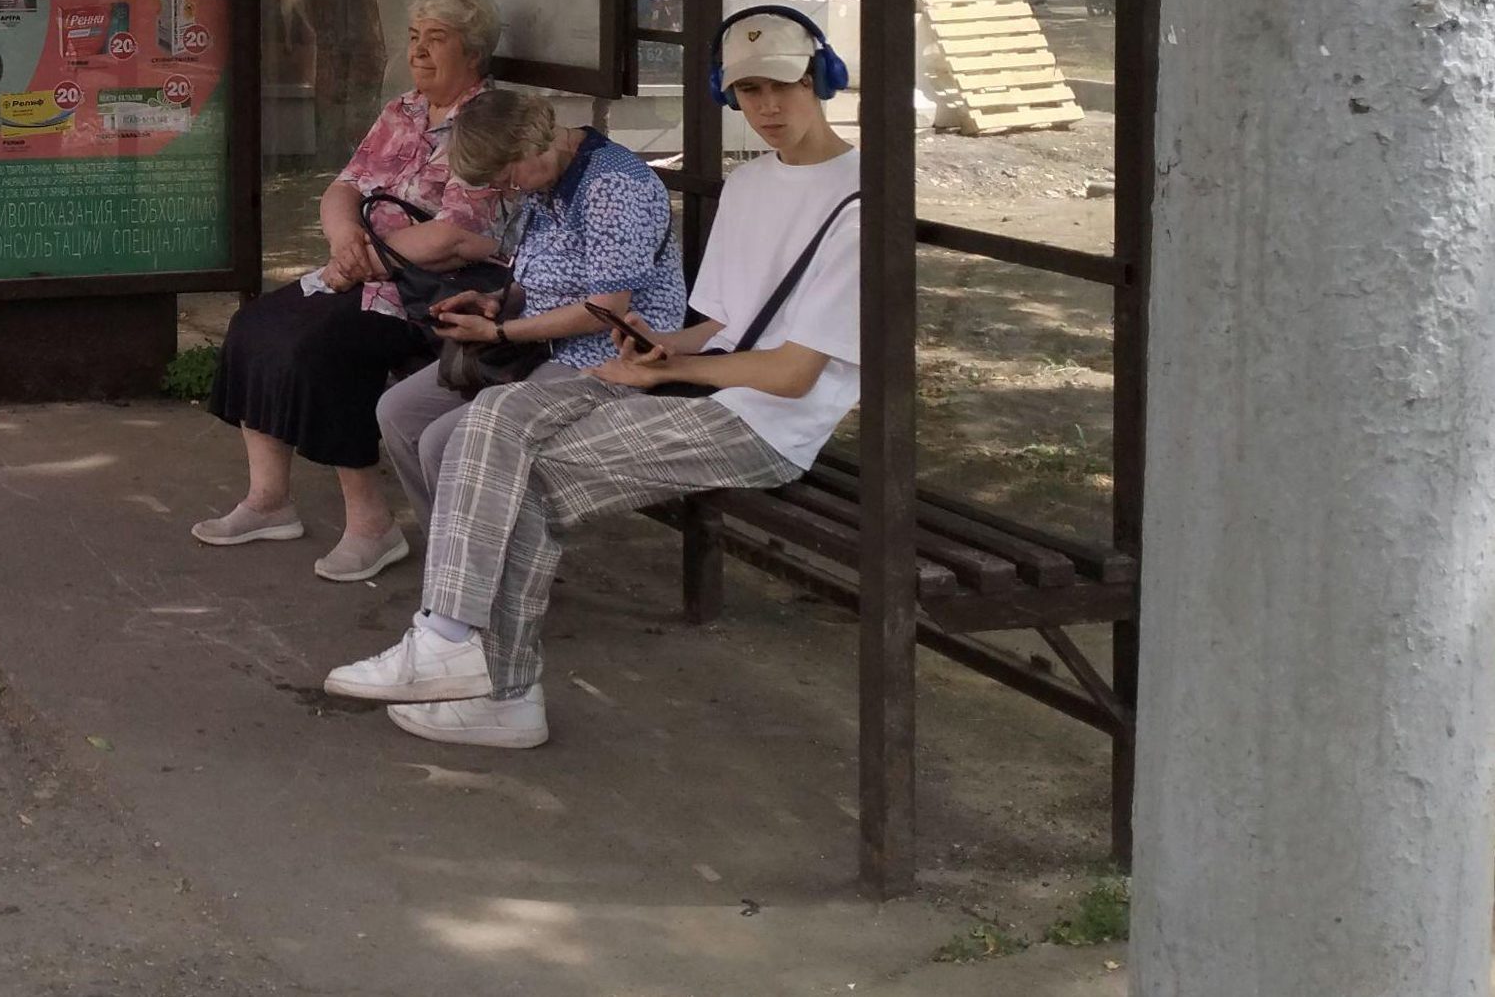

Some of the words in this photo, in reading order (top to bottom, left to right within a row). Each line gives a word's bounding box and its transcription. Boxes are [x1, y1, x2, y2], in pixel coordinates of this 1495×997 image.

[69, 14, 105, 26] Ренни
[120, 196, 218, 225] НЕОБХОДИМО
[112, 225, 219, 255] СПЕЦИАЛИСТА
